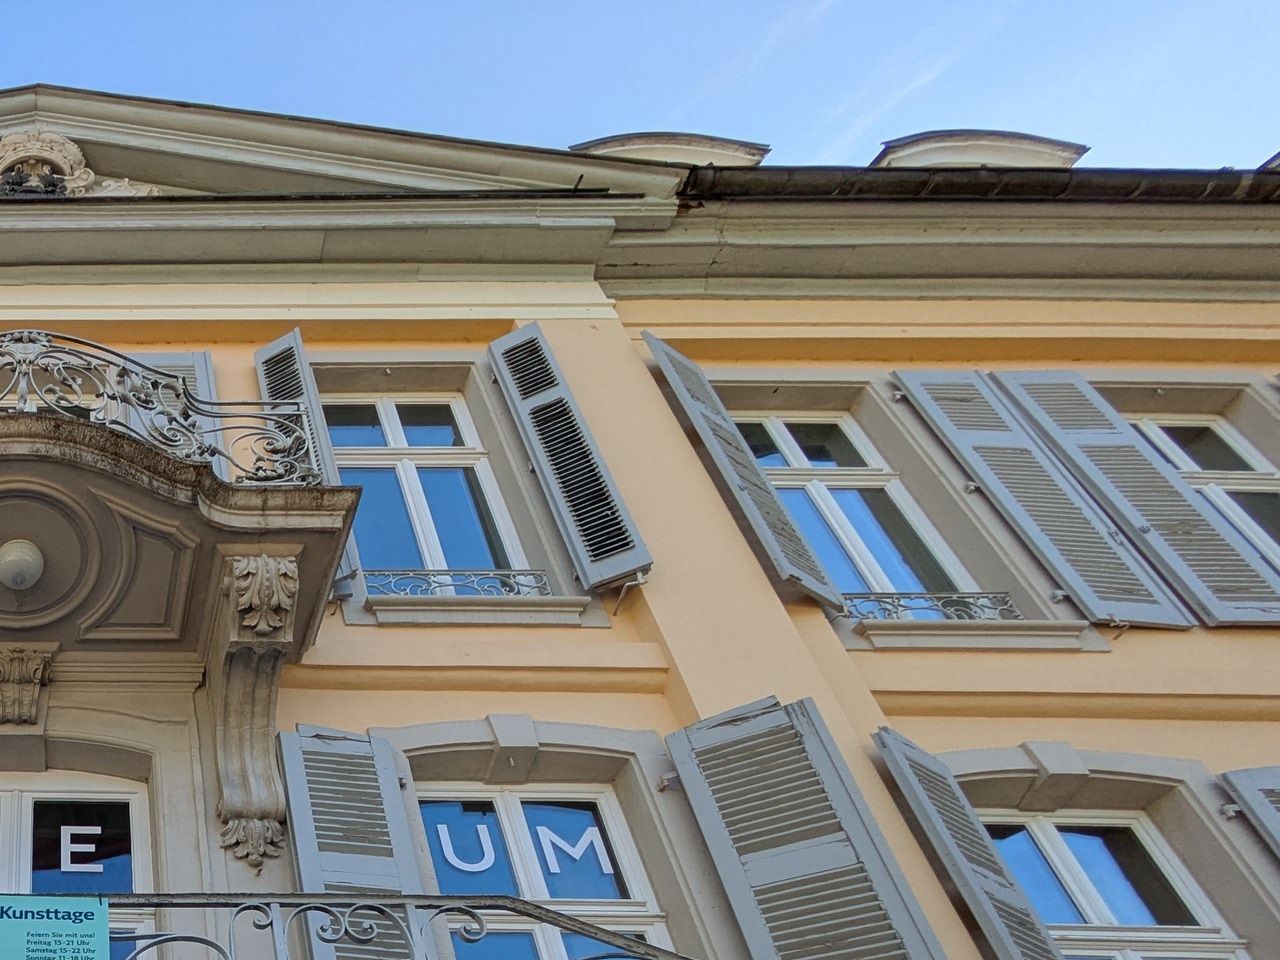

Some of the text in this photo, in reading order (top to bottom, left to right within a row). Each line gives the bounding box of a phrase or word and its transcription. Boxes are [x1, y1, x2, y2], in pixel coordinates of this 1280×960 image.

[0, 905, 95, 925] Kunsttage
[26, 939, 52, 947] Freitag
[25, 947, 58, 955] Samstag
